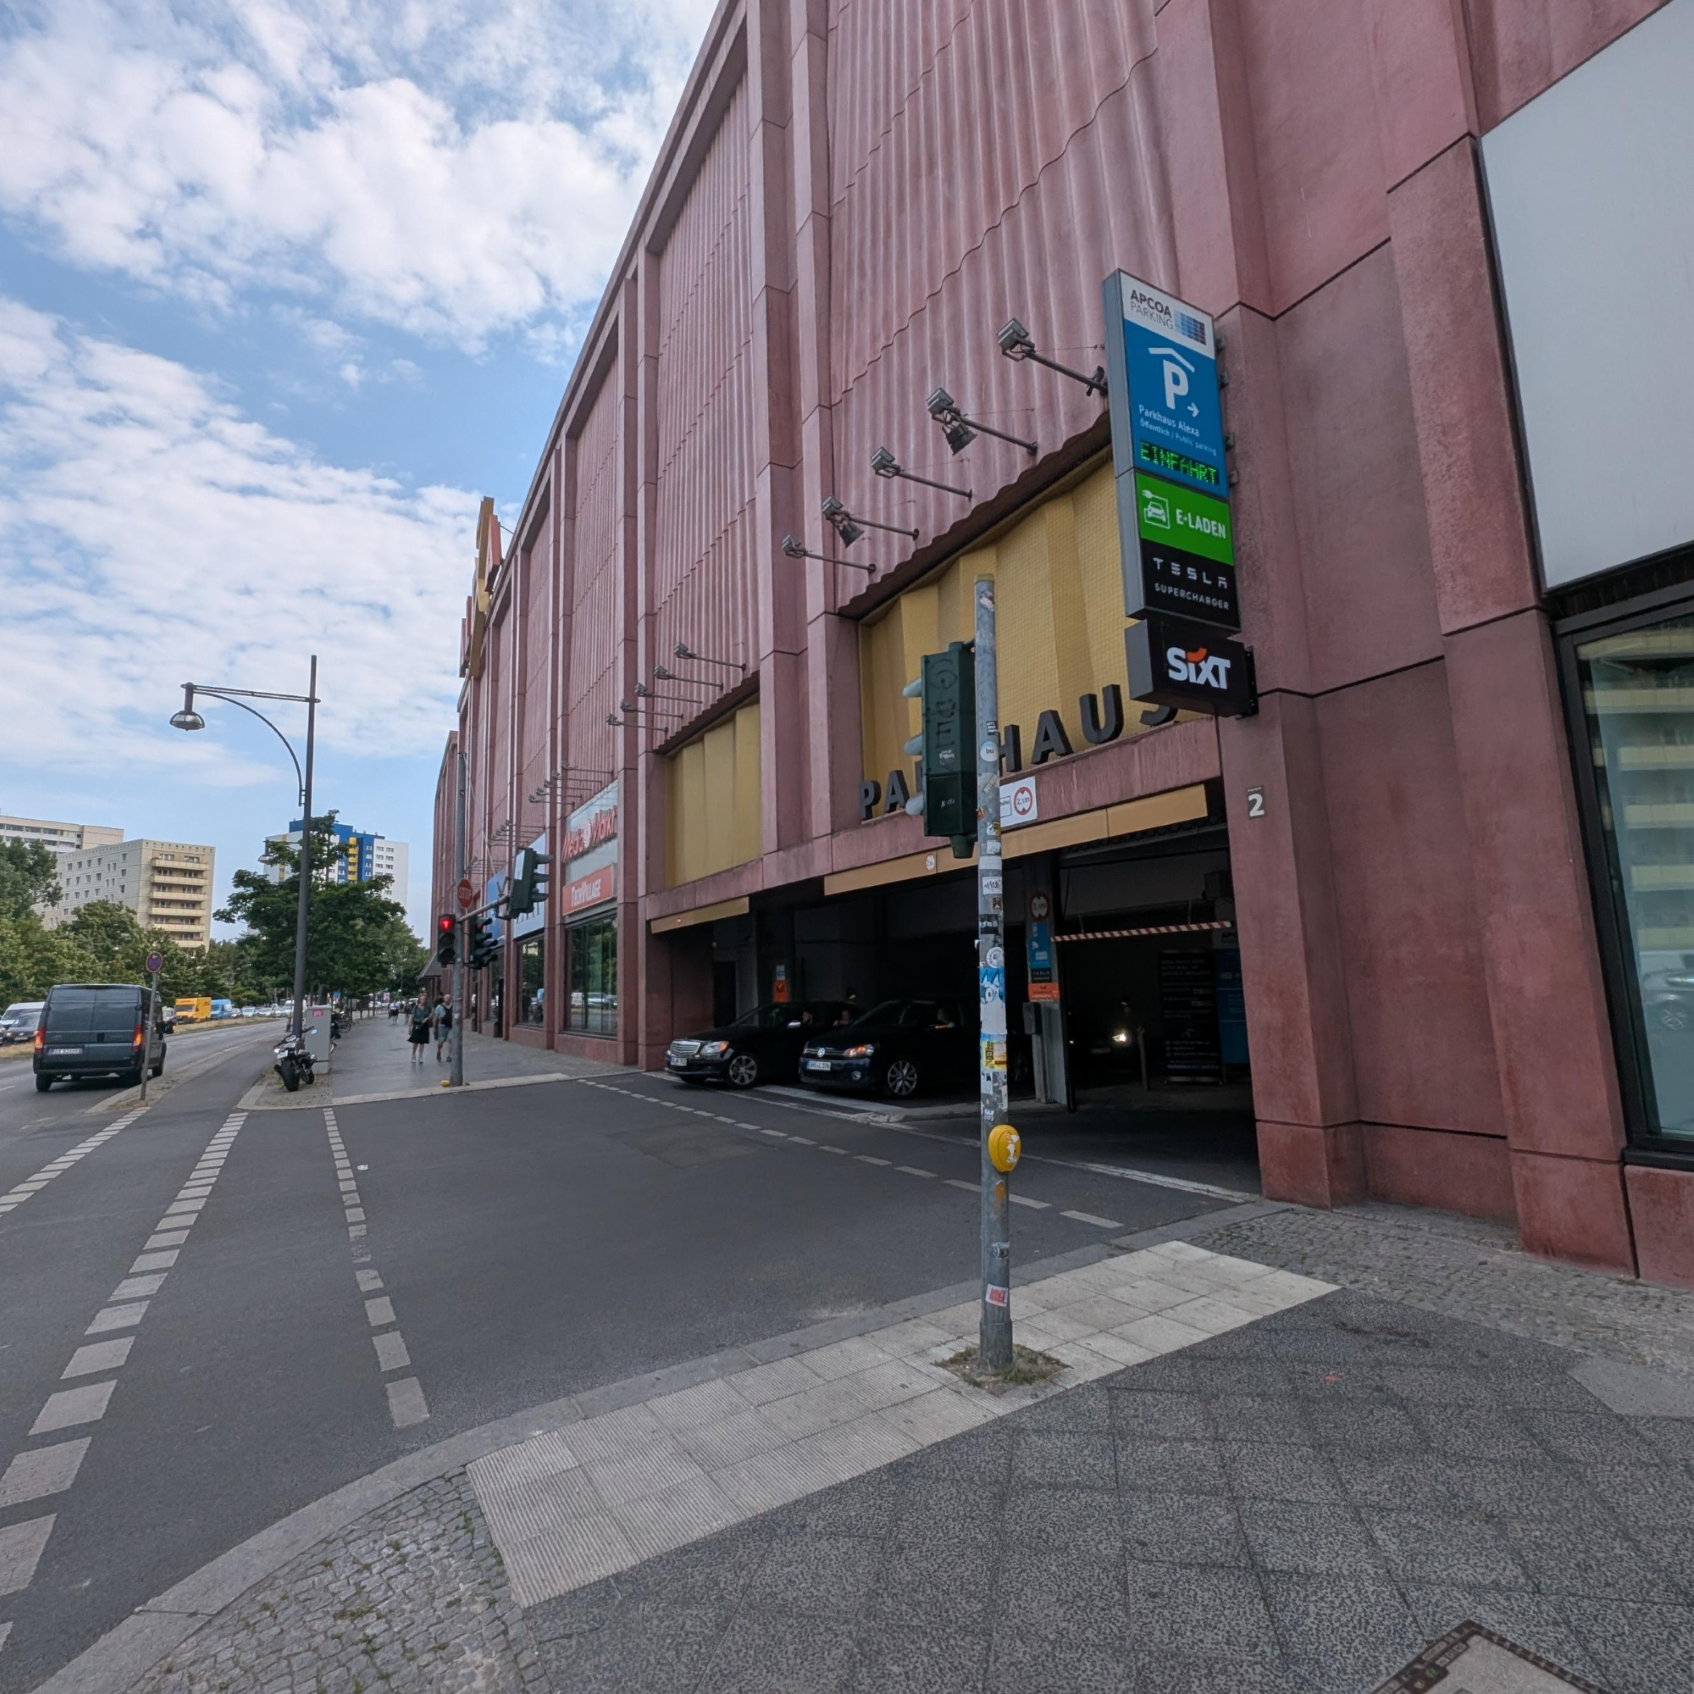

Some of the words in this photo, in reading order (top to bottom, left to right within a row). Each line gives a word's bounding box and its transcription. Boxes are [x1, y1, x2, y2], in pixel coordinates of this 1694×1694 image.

[1130, 289, 1172, 318] APCOA
[1130, 301, 1174, 330] PARKING
[1162, 359, 1189, 410] P
[1138, 404, 1176, 429] Parkhaus
[1178, 419, 1200, 437] Alexa
[1139, 417, 1171, 437] Öffentlich
[1175, 432, 1194, 448] Public
[1194, 440, 1218, 457] parking
[1140, 442, 1218, 485] EINFAHRT
[1152, 557, 1228, 590] TESLA
[1154, 582, 1230, 611] SUPERCHARGER
[1247, 793, 1265, 817] 2
[458, 886, 472, 900] STOP
